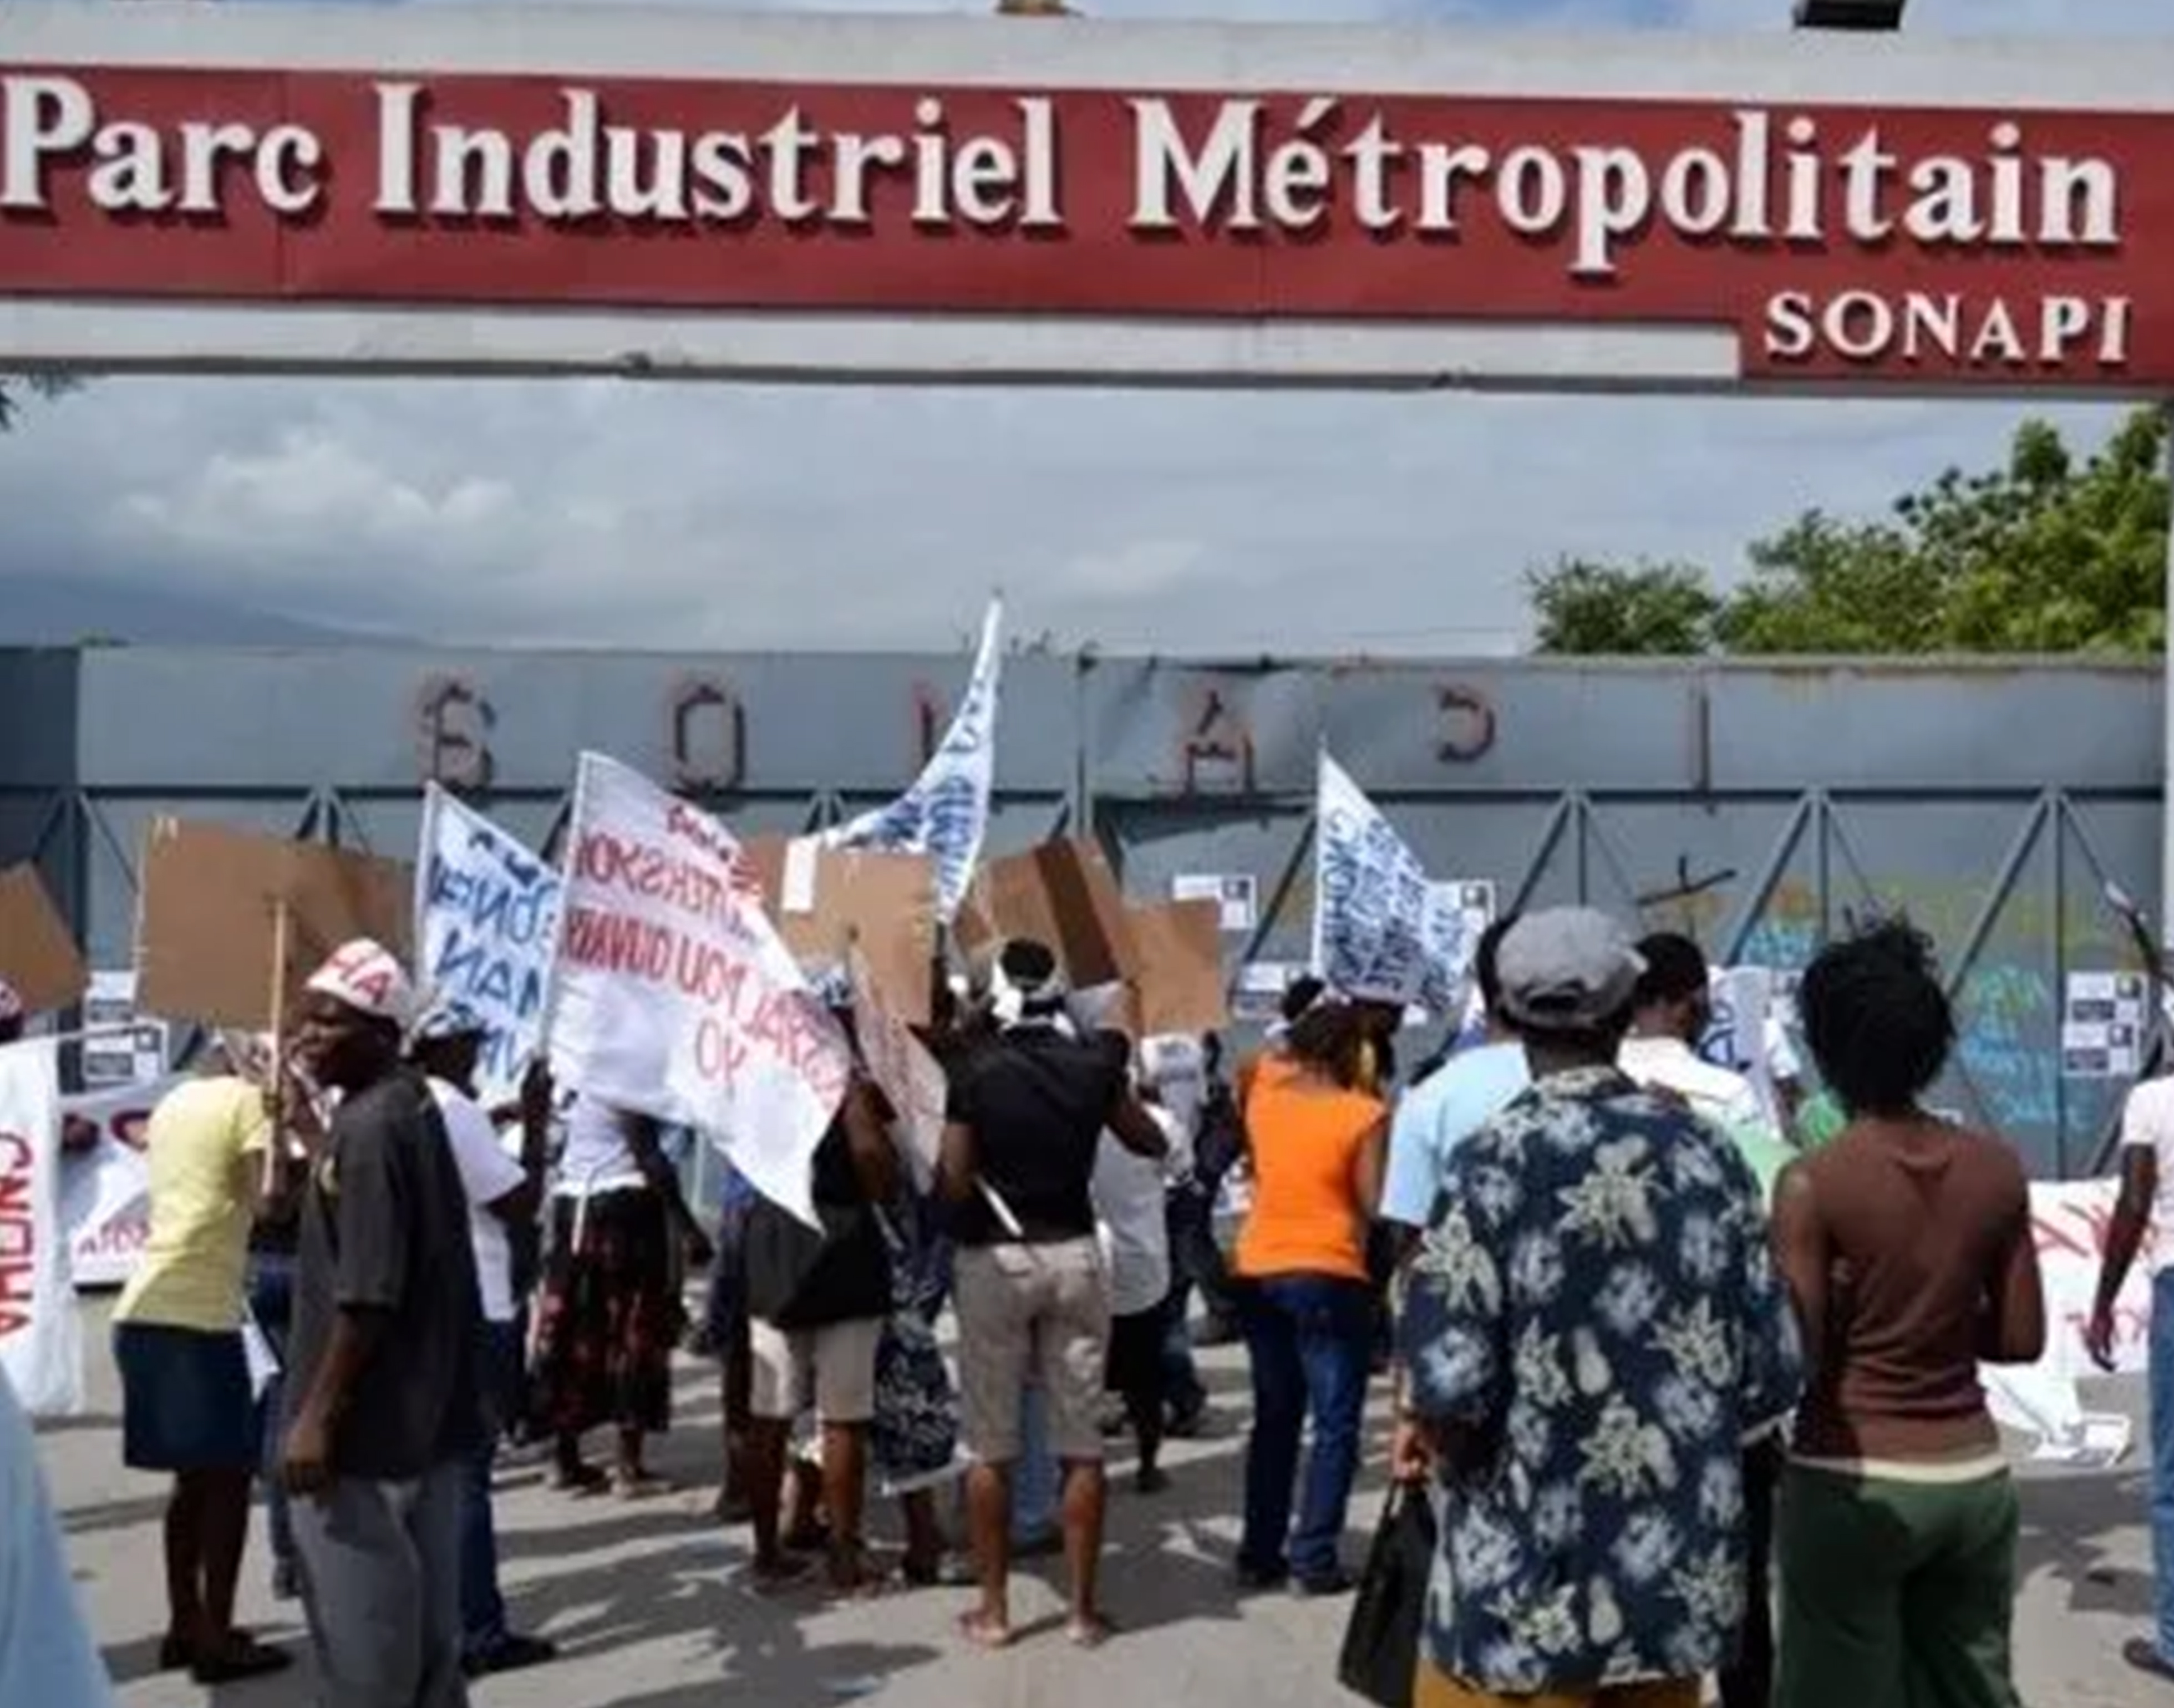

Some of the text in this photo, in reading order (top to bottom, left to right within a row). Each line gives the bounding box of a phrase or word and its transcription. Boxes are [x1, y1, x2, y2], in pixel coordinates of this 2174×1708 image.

[0, 77, 2121, 273] Parc Industriel Métropolitain
[1765, 291, 2129, 363] SONAPI
